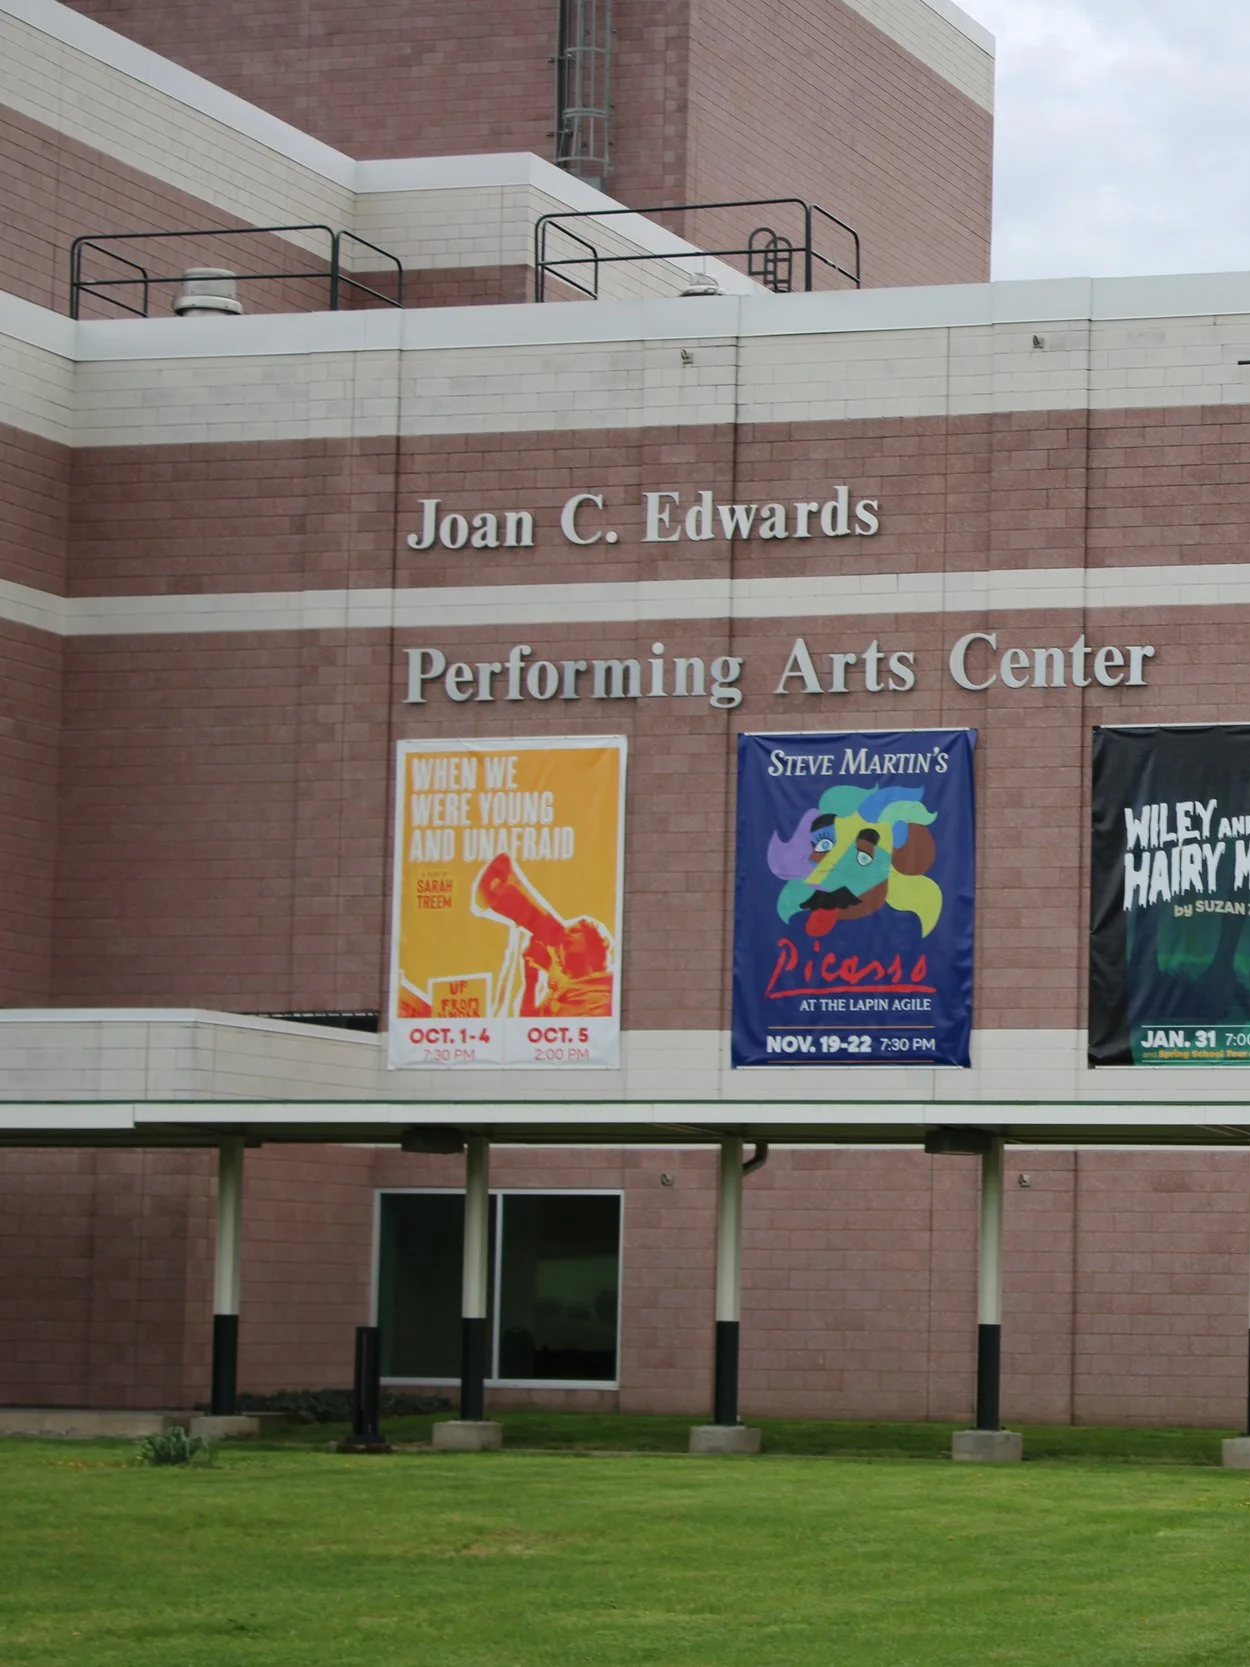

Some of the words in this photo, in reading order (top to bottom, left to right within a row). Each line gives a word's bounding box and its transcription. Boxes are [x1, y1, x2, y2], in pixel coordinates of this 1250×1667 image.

[407, 498, 535, 550] Joan
[560, 492, 619, 545] C.
[640, 485, 881, 543] Edwards
[402, 642, 744, 709] Performing
[774, 638, 916, 695] Arts
[948, 631, 1156, 691] Center
[767, 750, 834, 776] STEVE
[839, 746, 949, 774] MARTIN'S
[411, 757, 478, 791] WHEN
[484, 756, 519, 790] WE
[411, 793, 472, 827] WERE
[479, 790, 554, 826] YOUNG
[1123, 799, 1217, 850] WILEY
[409, 829, 456, 863] AND
[463, 826, 575, 863] UNAFRAID
[1123, 842, 1225, 911] HAIRY
[416, 879, 453, 894] SARAH
[417, 895, 452, 909] TREEM
[1173, 904, 1193, 917] by
[1195, 900, 1246, 915] SUZAN
[764, 938, 930, 999] Picasso
[449, 980, 468, 996] UP
[799, 999, 816, 1011] AT
[819, 998, 846, 1011] THE
[849, 998, 888, 1010] LAPIN
[892, 998, 931, 1010] AGILE
[410, 1028, 455, 1044] OCT.
[460, 1027, 490, 1043] 1-4
[527, 1028, 573, 1043] OCT.
[578, 1027, 589, 1042] 5
[766, 1036, 815, 1053] NOV.
[819, 1035, 872, 1052] 19-22
[880, 1038, 909, 1051] 7:30
[912, 1038, 936, 1050] PM
[1141, 1030, 1191, 1048] JAN.
[1195, 1030, 1216, 1047] 31
[424, 1049, 450, 1061] 7:30
[454, 1049, 475, 1060] PM
[534, 1049, 563, 1060] 2:00
[568, 1049, 590, 1060] PM
[1158, 1050, 1190, 1059] Spring
[1191, 1050, 1224, 1058] School
[1226, 1049, 1247, 1058] Tour
